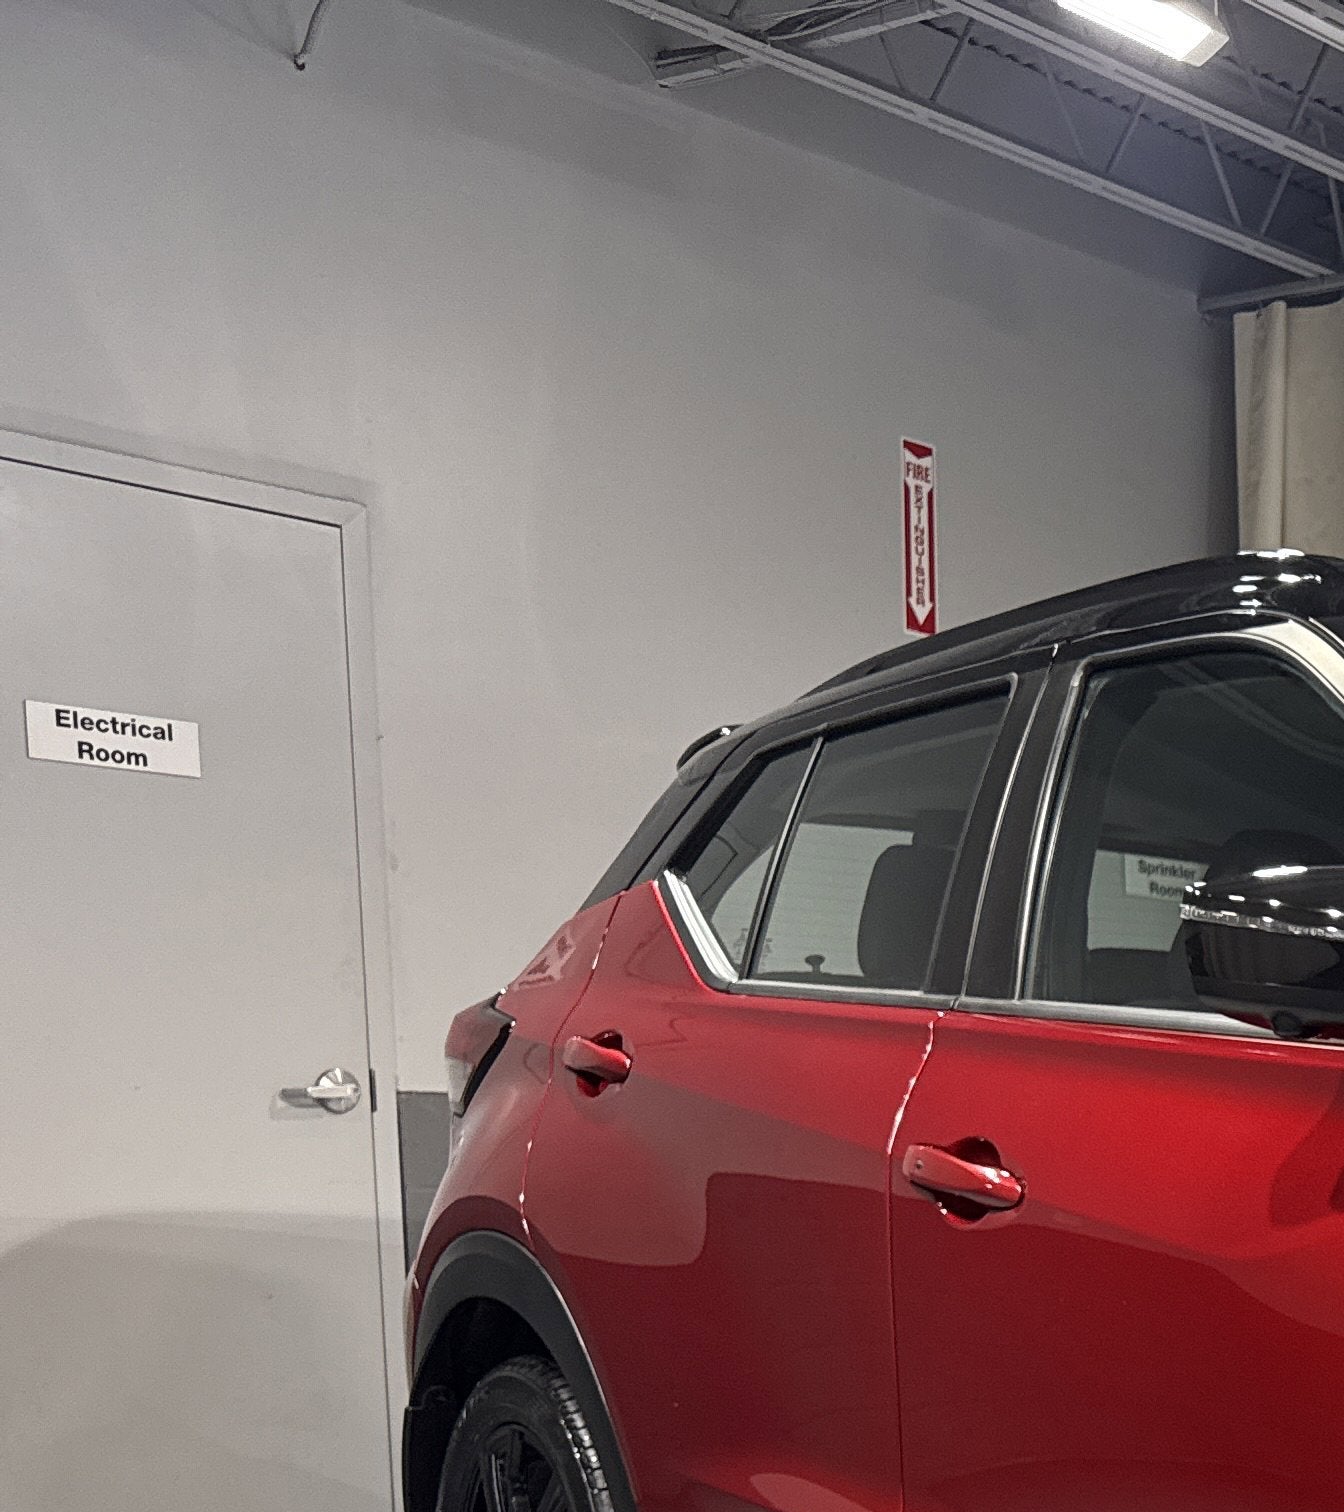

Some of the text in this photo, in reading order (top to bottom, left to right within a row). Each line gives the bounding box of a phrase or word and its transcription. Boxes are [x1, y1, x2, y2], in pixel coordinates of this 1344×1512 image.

[905, 461, 931, 484] FIRE
[913, 484, 926, 608] EXTINGUISHER
[54, 708, 174, 742] Electrical
[77, 740, 149, 768] Room
